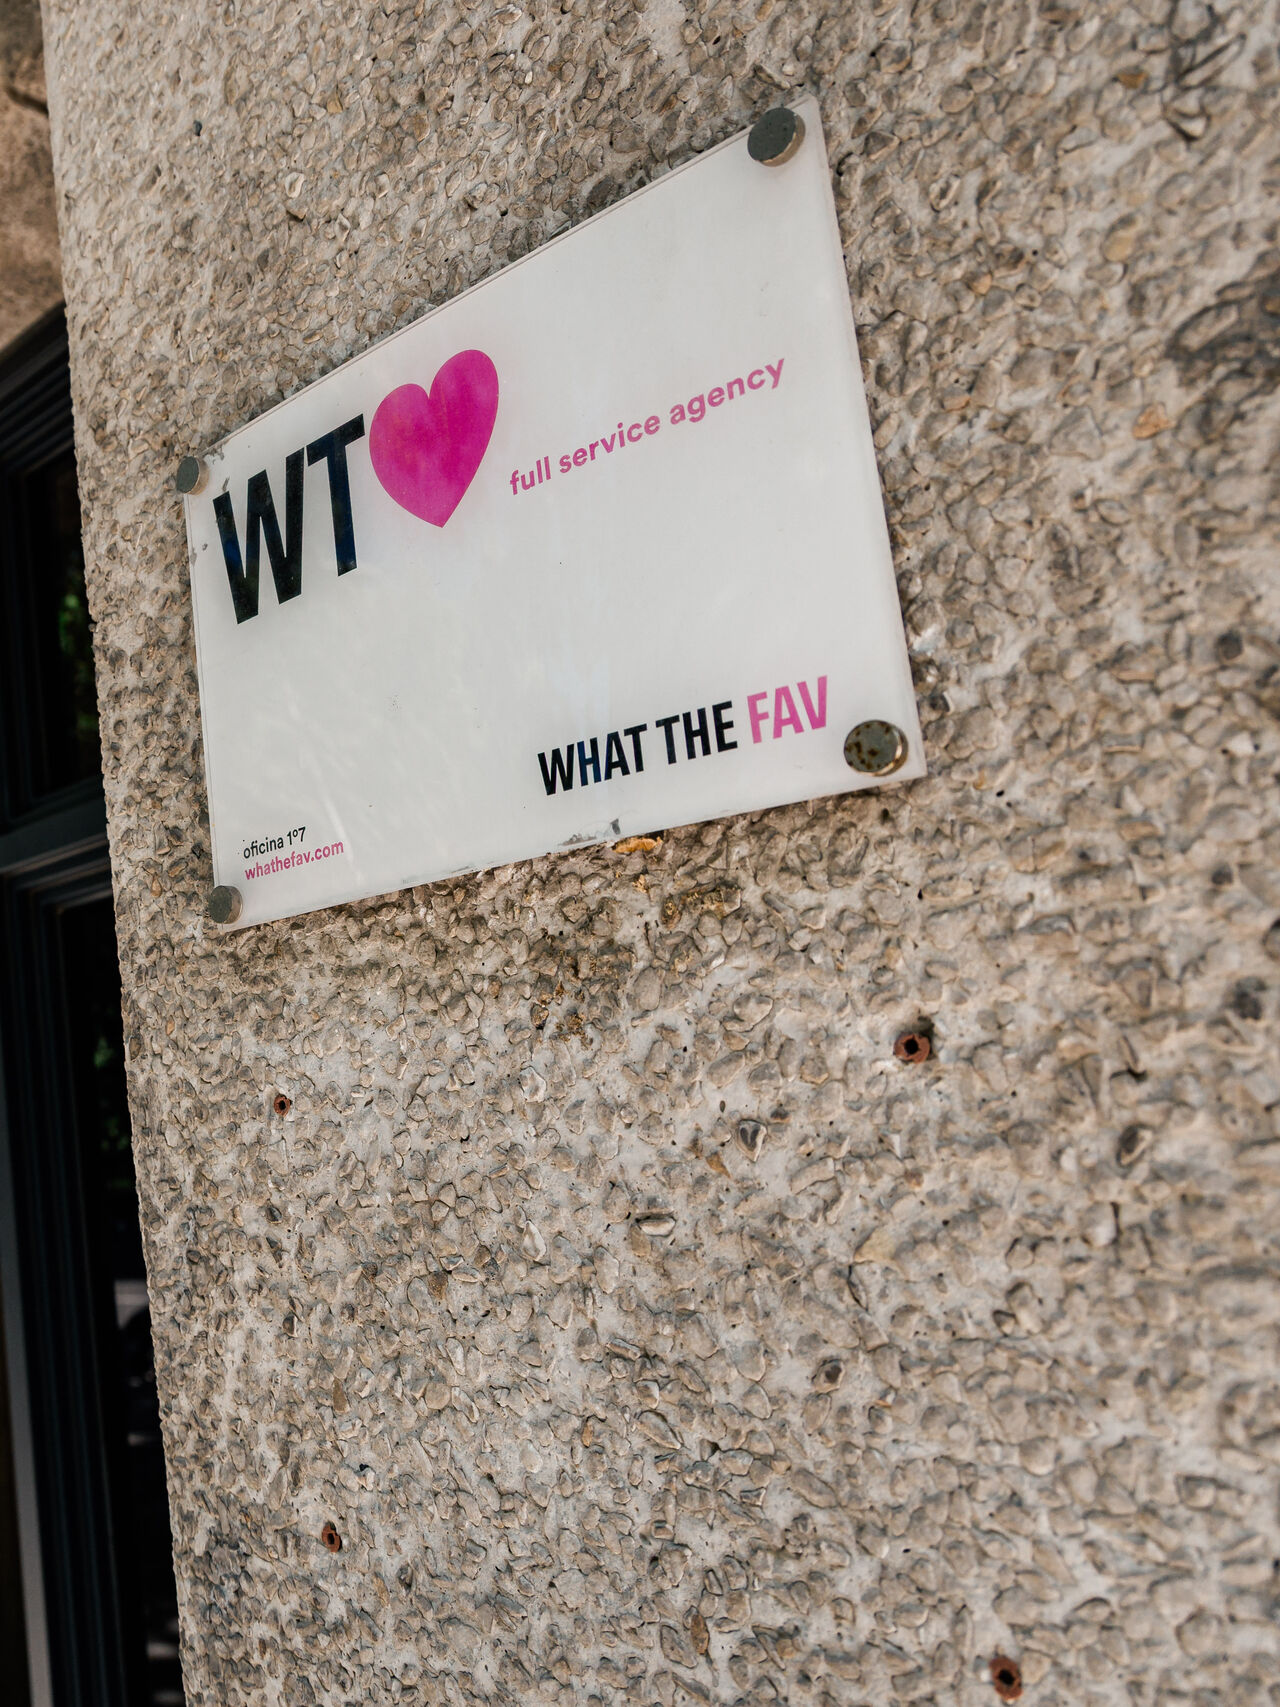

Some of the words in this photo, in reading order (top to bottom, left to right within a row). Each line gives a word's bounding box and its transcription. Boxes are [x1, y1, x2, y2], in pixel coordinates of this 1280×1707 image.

[509, 456, 552, 495] full
[558, 415, 661, 474] service
[669, 358, 785, 424] agency
[212, 413, 366, 625] WT
[537, 723, 648, 796] WHAT
[655, 700, 738, 765] THE
[746, 675, 828, 744] FAV
[243, 837, 284, 859] oficina
[244, 841, 344, 881] whathefav.com
